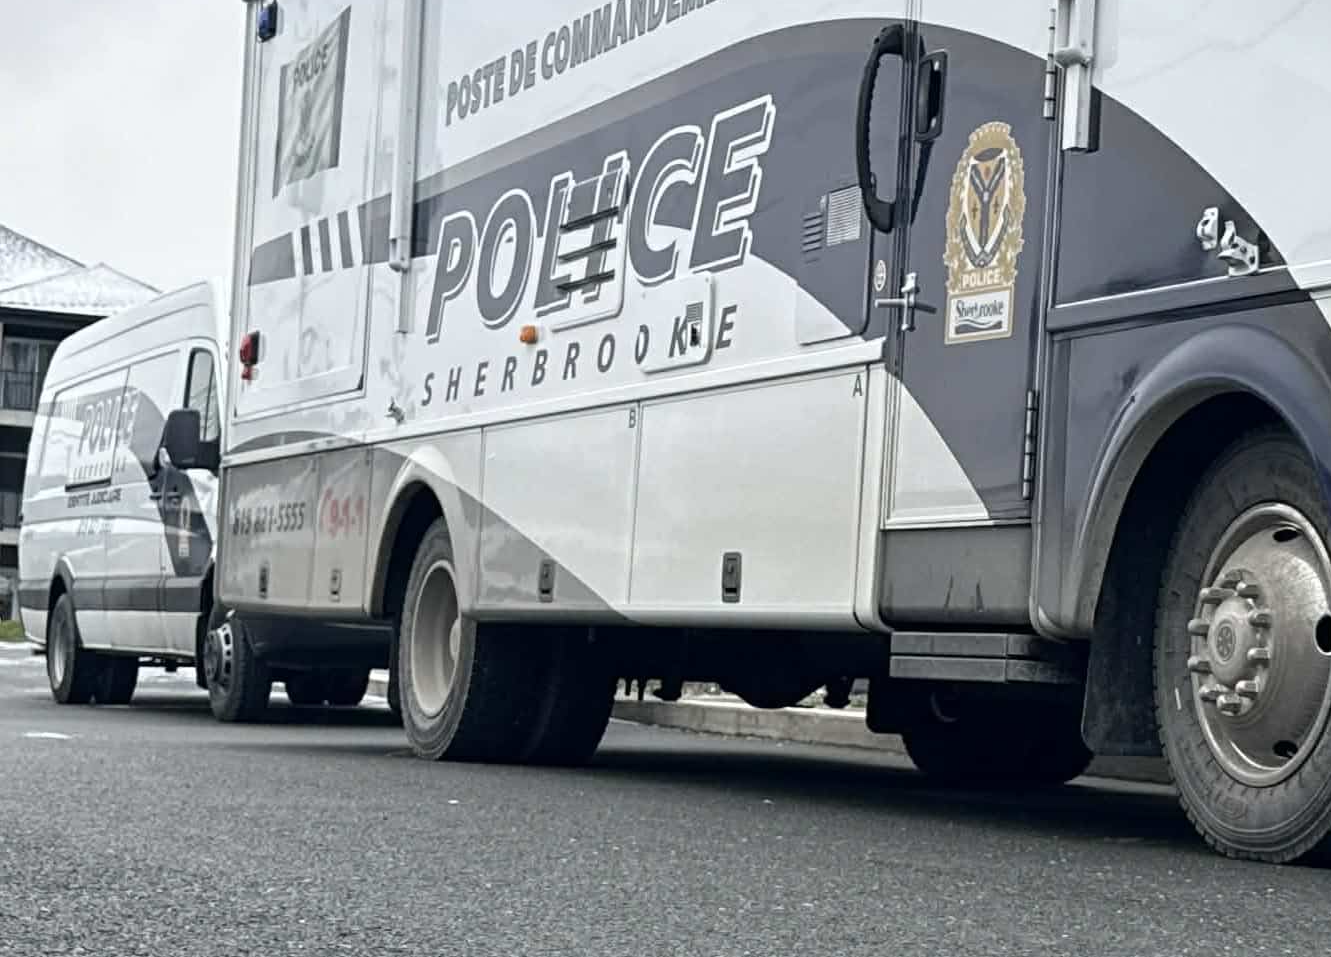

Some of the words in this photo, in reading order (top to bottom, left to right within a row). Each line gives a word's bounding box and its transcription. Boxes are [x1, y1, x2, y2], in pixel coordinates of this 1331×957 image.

[292, 43, 328, 94] POLICE
[446, 56, 505, 126] POSTE
[508, 40, 537, 98] DE
[426, 94, 776, 344] POLICE
[962, 270, 1001, 287] POLICE
[421, 305, 738, 406] SHERBROOKE
[852, 374, 863, 397] A
[628, 408, 637, 429] B
